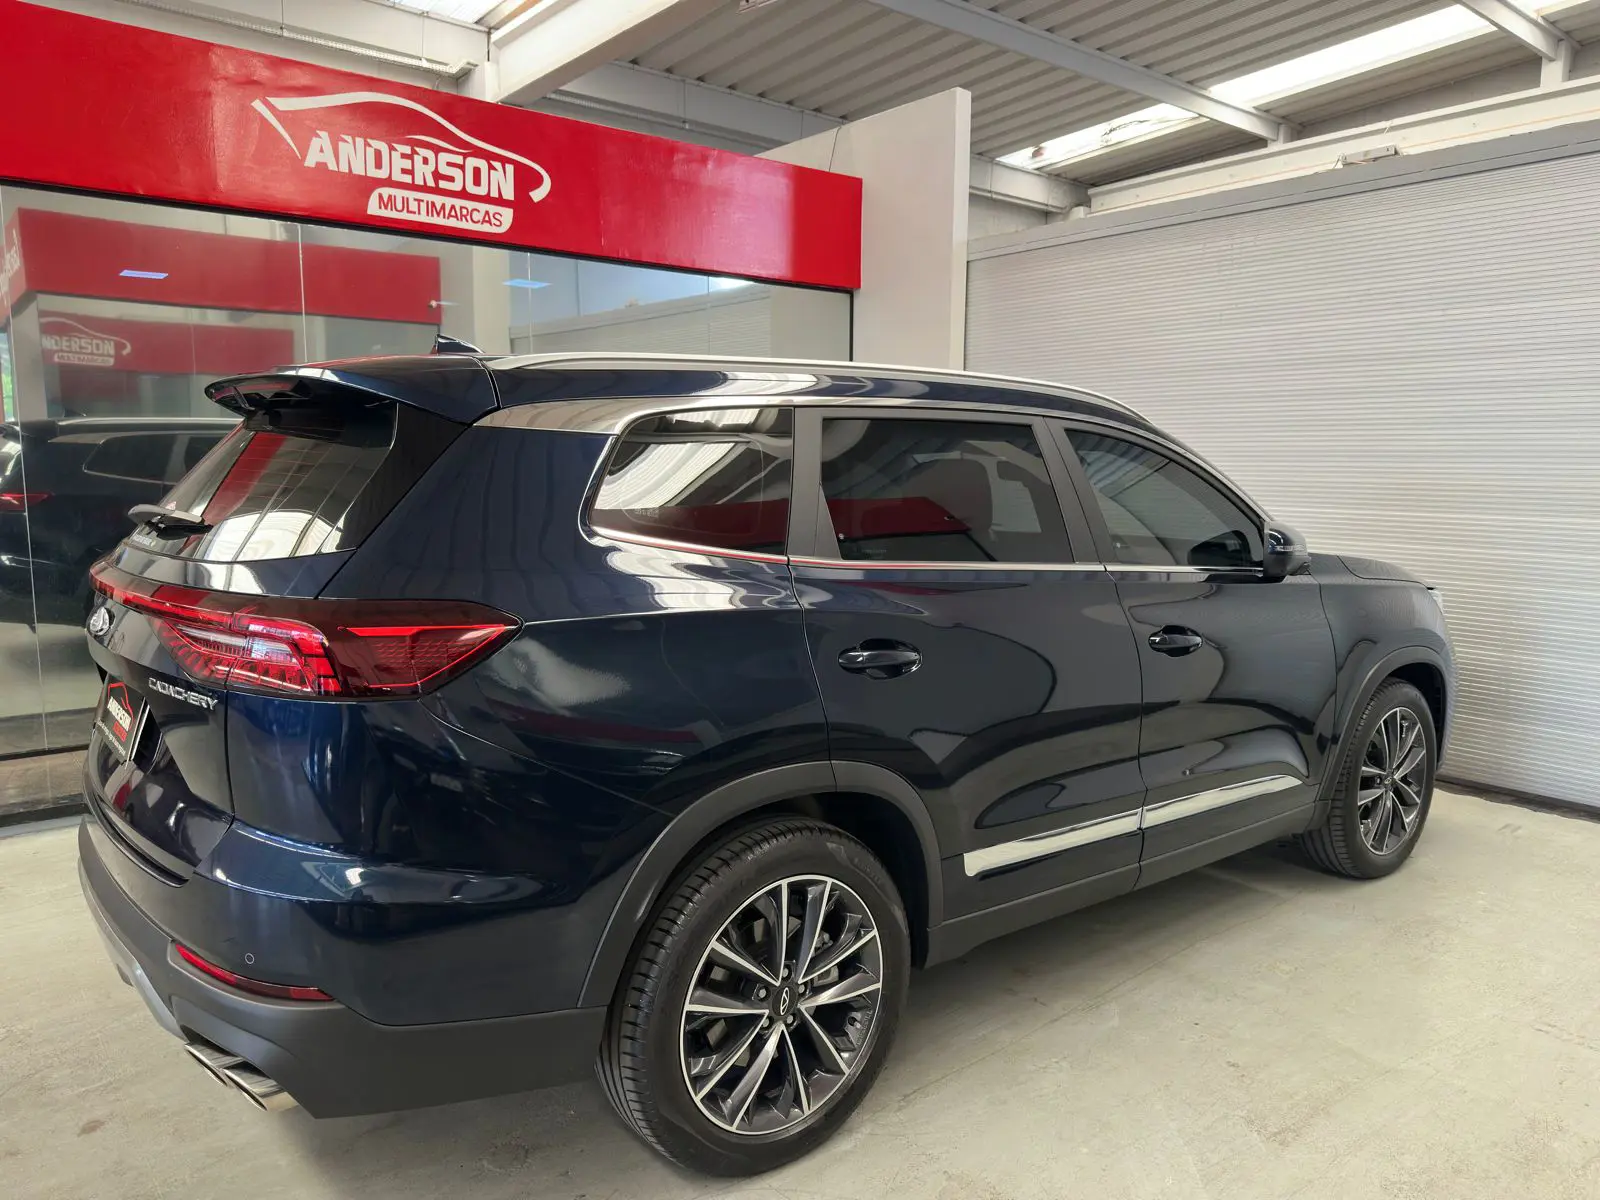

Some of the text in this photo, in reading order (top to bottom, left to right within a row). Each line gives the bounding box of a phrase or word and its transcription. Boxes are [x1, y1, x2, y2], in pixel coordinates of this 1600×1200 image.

[304, 130, 514, 200] ANDERSON
[378, 192, 503, 228] MULTIMARCAS
[41, 334, 115, 356] NDERSON
